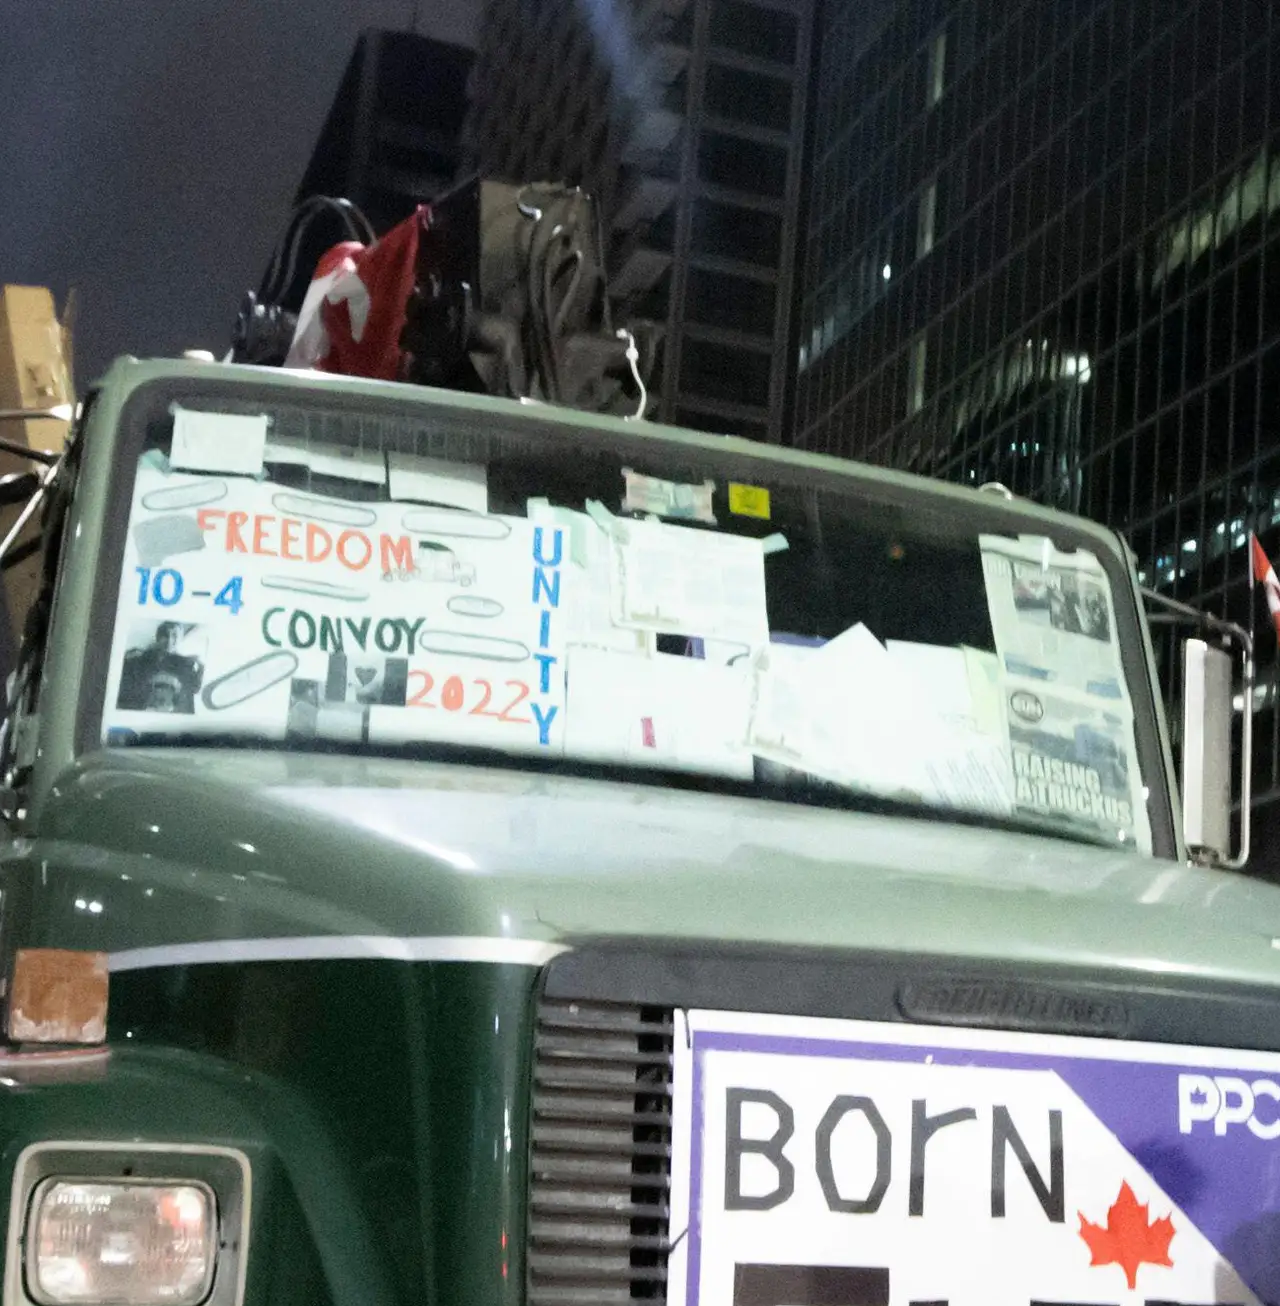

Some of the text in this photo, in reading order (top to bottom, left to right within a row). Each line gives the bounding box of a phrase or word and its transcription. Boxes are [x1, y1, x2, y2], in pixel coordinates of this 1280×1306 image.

[197, 509, 416, 575] FREEDOM
[134, 566, 244, 616] 10-4
[261, 607, 427, 656] CONVOY
[531, 526, 563, 745] UNITY
[406, 669, 532, 724] 2022
